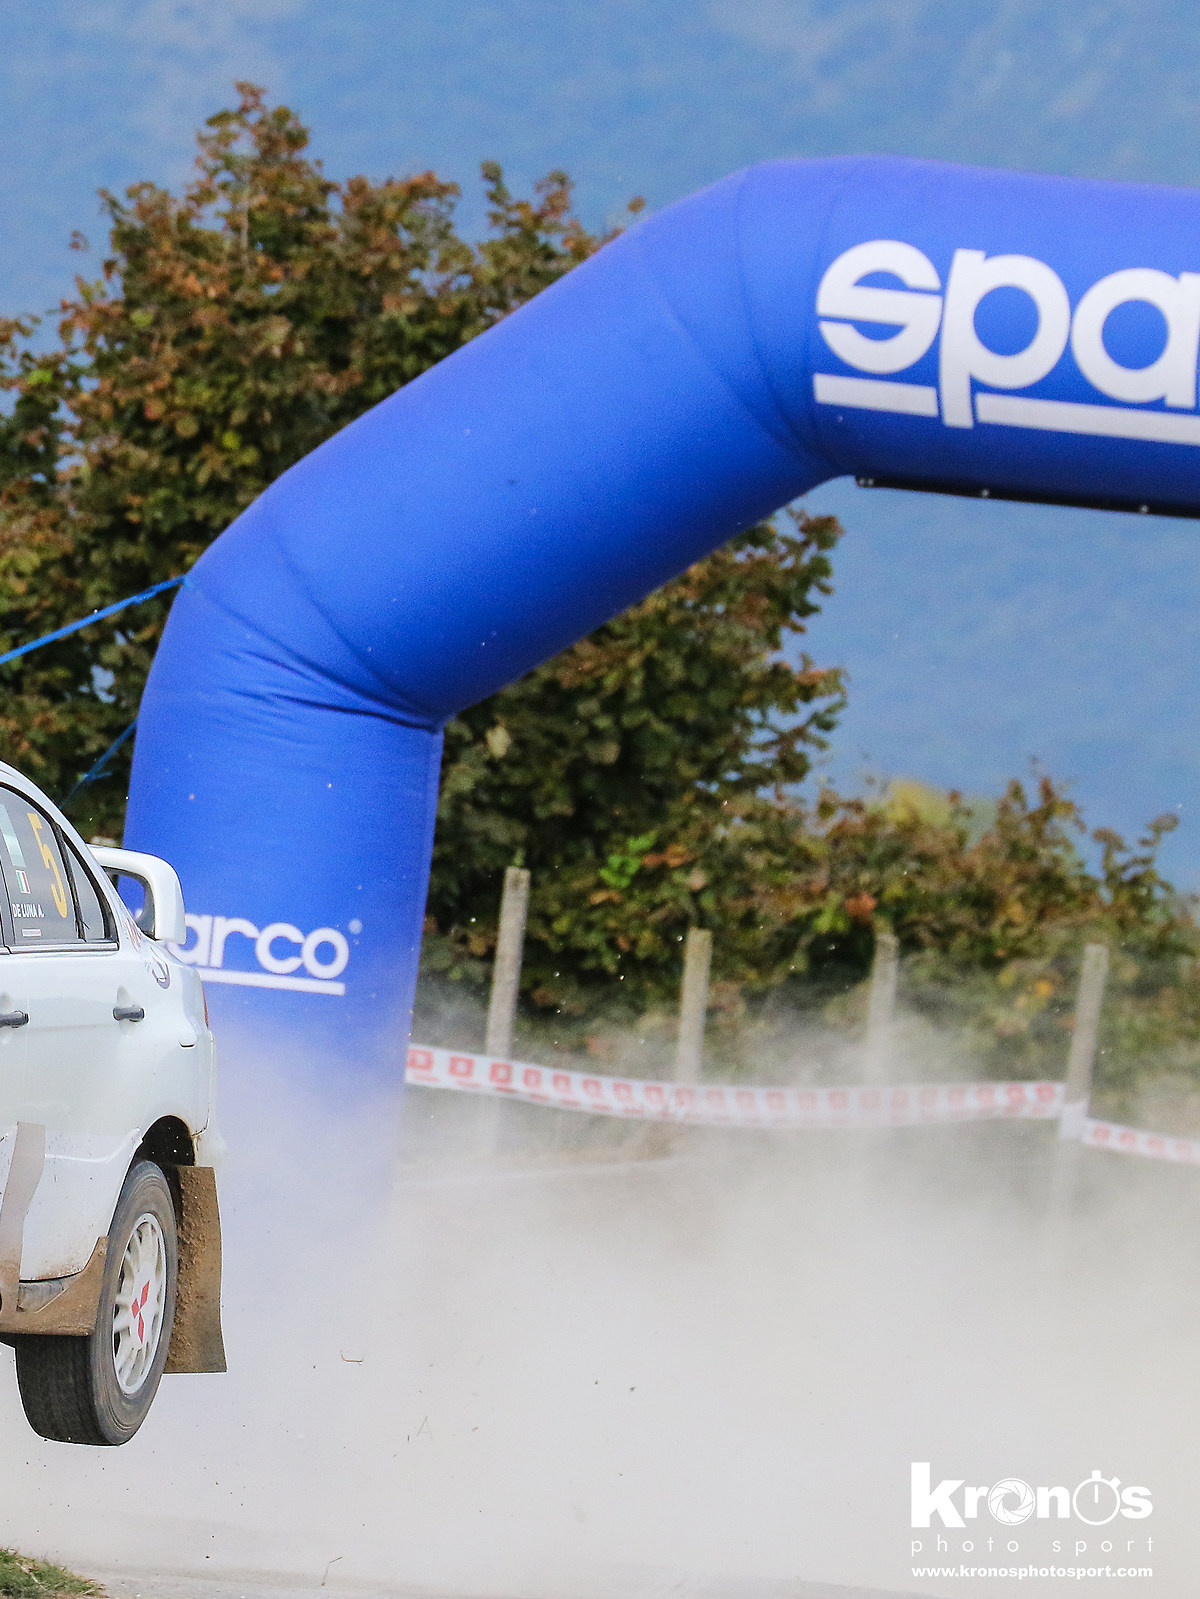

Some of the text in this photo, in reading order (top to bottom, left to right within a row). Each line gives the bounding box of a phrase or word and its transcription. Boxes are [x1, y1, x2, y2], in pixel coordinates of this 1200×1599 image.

[27, 812, 68, 918] 5
[12, 903, 22, 918] DE
[165, 911, 350, 980] arco
